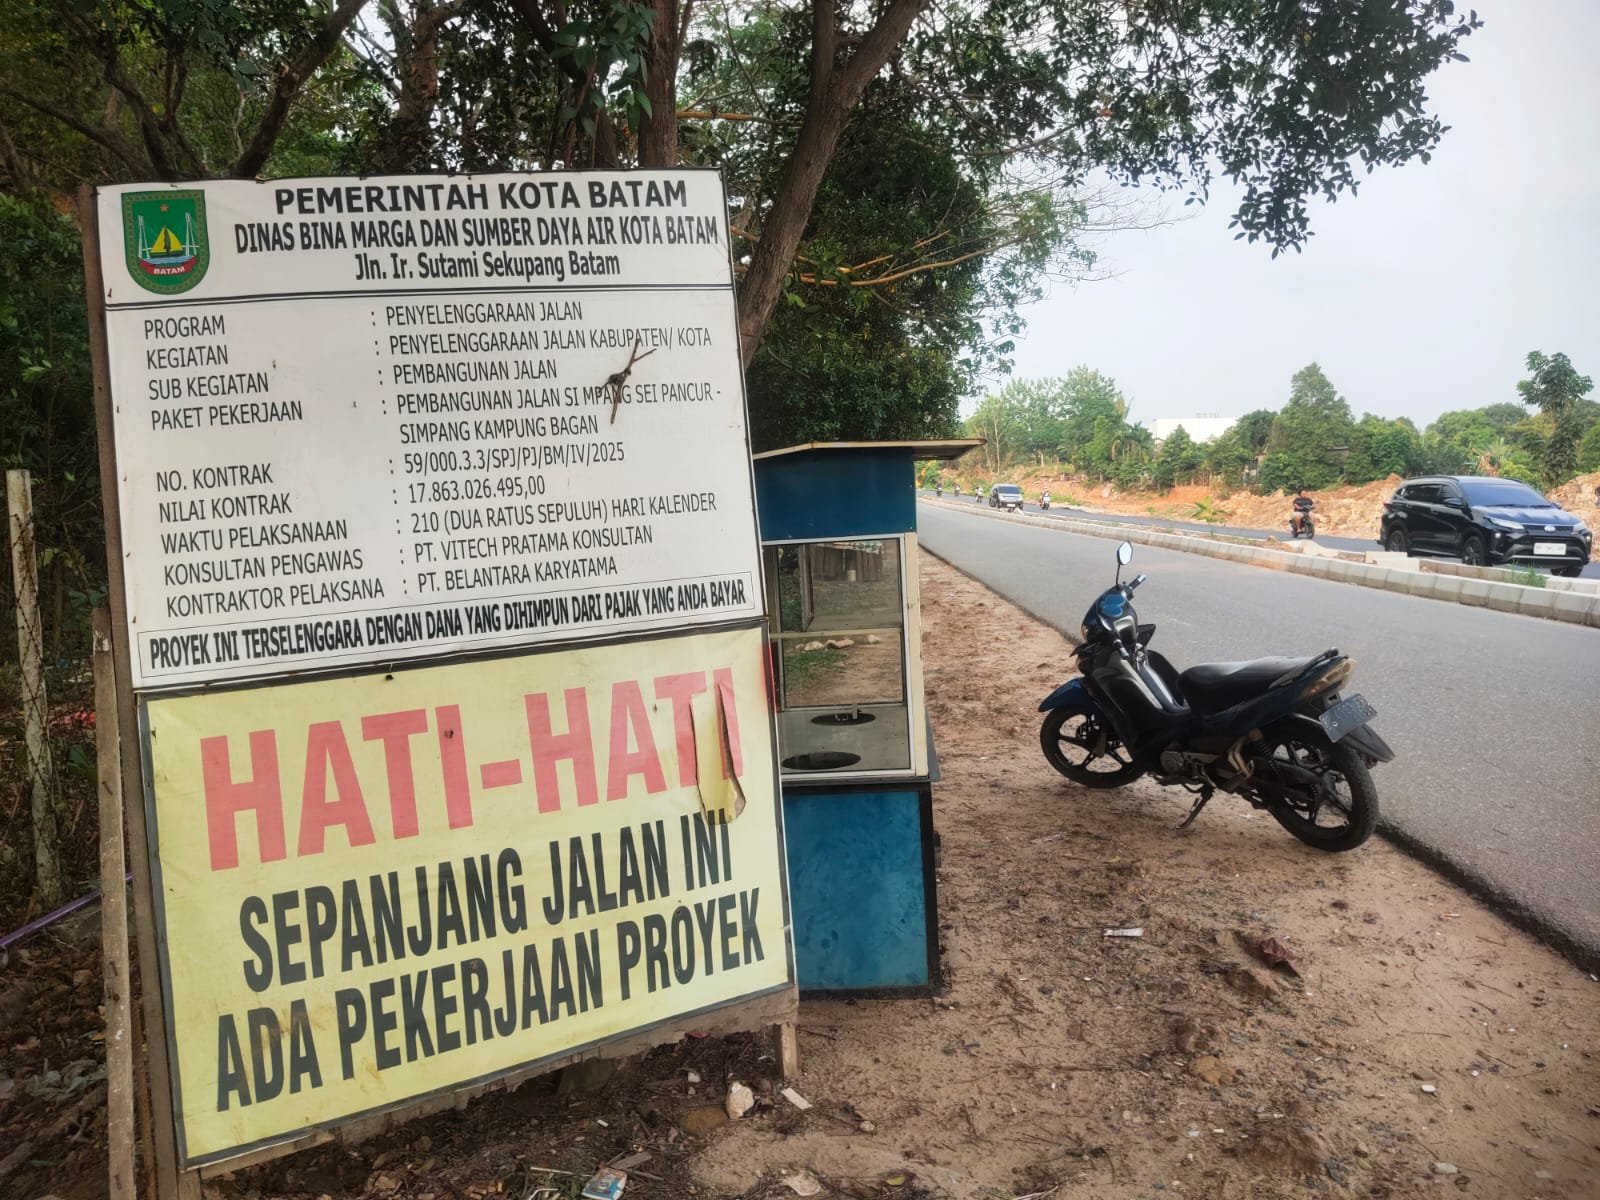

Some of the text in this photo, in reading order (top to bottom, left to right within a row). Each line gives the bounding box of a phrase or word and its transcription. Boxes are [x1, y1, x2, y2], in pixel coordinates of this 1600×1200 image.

[275, 180, 686, 214] PEMERINTAH KOTA BATAM
[235, 216, 718, 253] DINAS BINA MARGA DAN SUMBER DAYA AIR KOTA BATAM
[153, 267, 185, 275] BATAM
[355, 250, 620, 282] Jln. Ir. Sutami Sekupang Batam
[145, 315, 225, 339] PROGRAM
[386, 303, 535, 326] PENYELENGGARAAN
[540, 302, 582, 321] JALAN
[147, 345, 228, 369] KEGIATAN
[390, 331, 538, 355] PENYELENGGARAAN
[544, 330, 585, 350] JALAN
[590, 326, 673, 351] KABUPATEN/
[678, 328, 711, 346] KOTA
[149, 378, 182, 400] SUB
[187, 372, 268, 397] KEGIATAN
[393, 361, 509, 384] PEMBANGUNAN
[514, 360, 557, 380] JALAN
[152, 407, 203, 430] PAKET
[209, 401, 302, 426] PEKERJAAN
[397, 390, 512, 414] PEMBANGUNAN
[517, 388, 560, 408] JALAN
[636, 384, 657, 403] SEI
[662, 383, 713, 402] PANCUR
[400, 415, 598, 444] SIMPANG KAMPUNG BAGAN
[157, 471, 187, 492] NO.
[193, 463, 273, 489] KONTRAK
[405, 442, 624, 476] 59/000.3.3/SPJ/PJ/BM/IV/2025
[159, 500, 206, 523] NILAI
[212, 493, 292, 518] KONTRAK
[409, 475, 545, 503] 17.863.026.495,00
[161, 529, 222, 554] WAKTU
[229, 520, 347, 548] PELAKSANAAN
[411, 512, 438, 533] 210
[444, 509, 482, 535] (DUA
[486, 505, 534, 527] RATUS
[538, 499, 607, 523] SEPULUH)
[612, 497, 645, 517] HARI
[649, 493, 716, 515] KALENDER
[164, 557, 265, 586] KONSULTAN
[271, 549, 363, 576] PENGAWAS
[415, 542, 436, 563] PT.
[441, 537, 497, 560] VITECH
[502, 532, 569, 555] PRATAMA
[573, 525, 652, 549] KONSULTAN
[167, 587, 285, 619] KONTRAKTOR
[290, 578, 384, 606] PELAKSANA
[418, 572, 439, 592] PT.
[445, 564, 531, 590] BELANTARA
[535, 556, 617, 582] KARYATAMA
[150, 579, 746, 669] PROYEK INI TERSELENGGARA DENGAN DANA YANG DIHIMPUN DARI PAJAK YANG ANDA BAYAR
[200, 668, 744, 871] HATI-HATI
[240, 808, 732, 992] SEPANJANG JALAN INI
[217, 888, 764, 1112] ADA PEKERJAAN PROYEK
